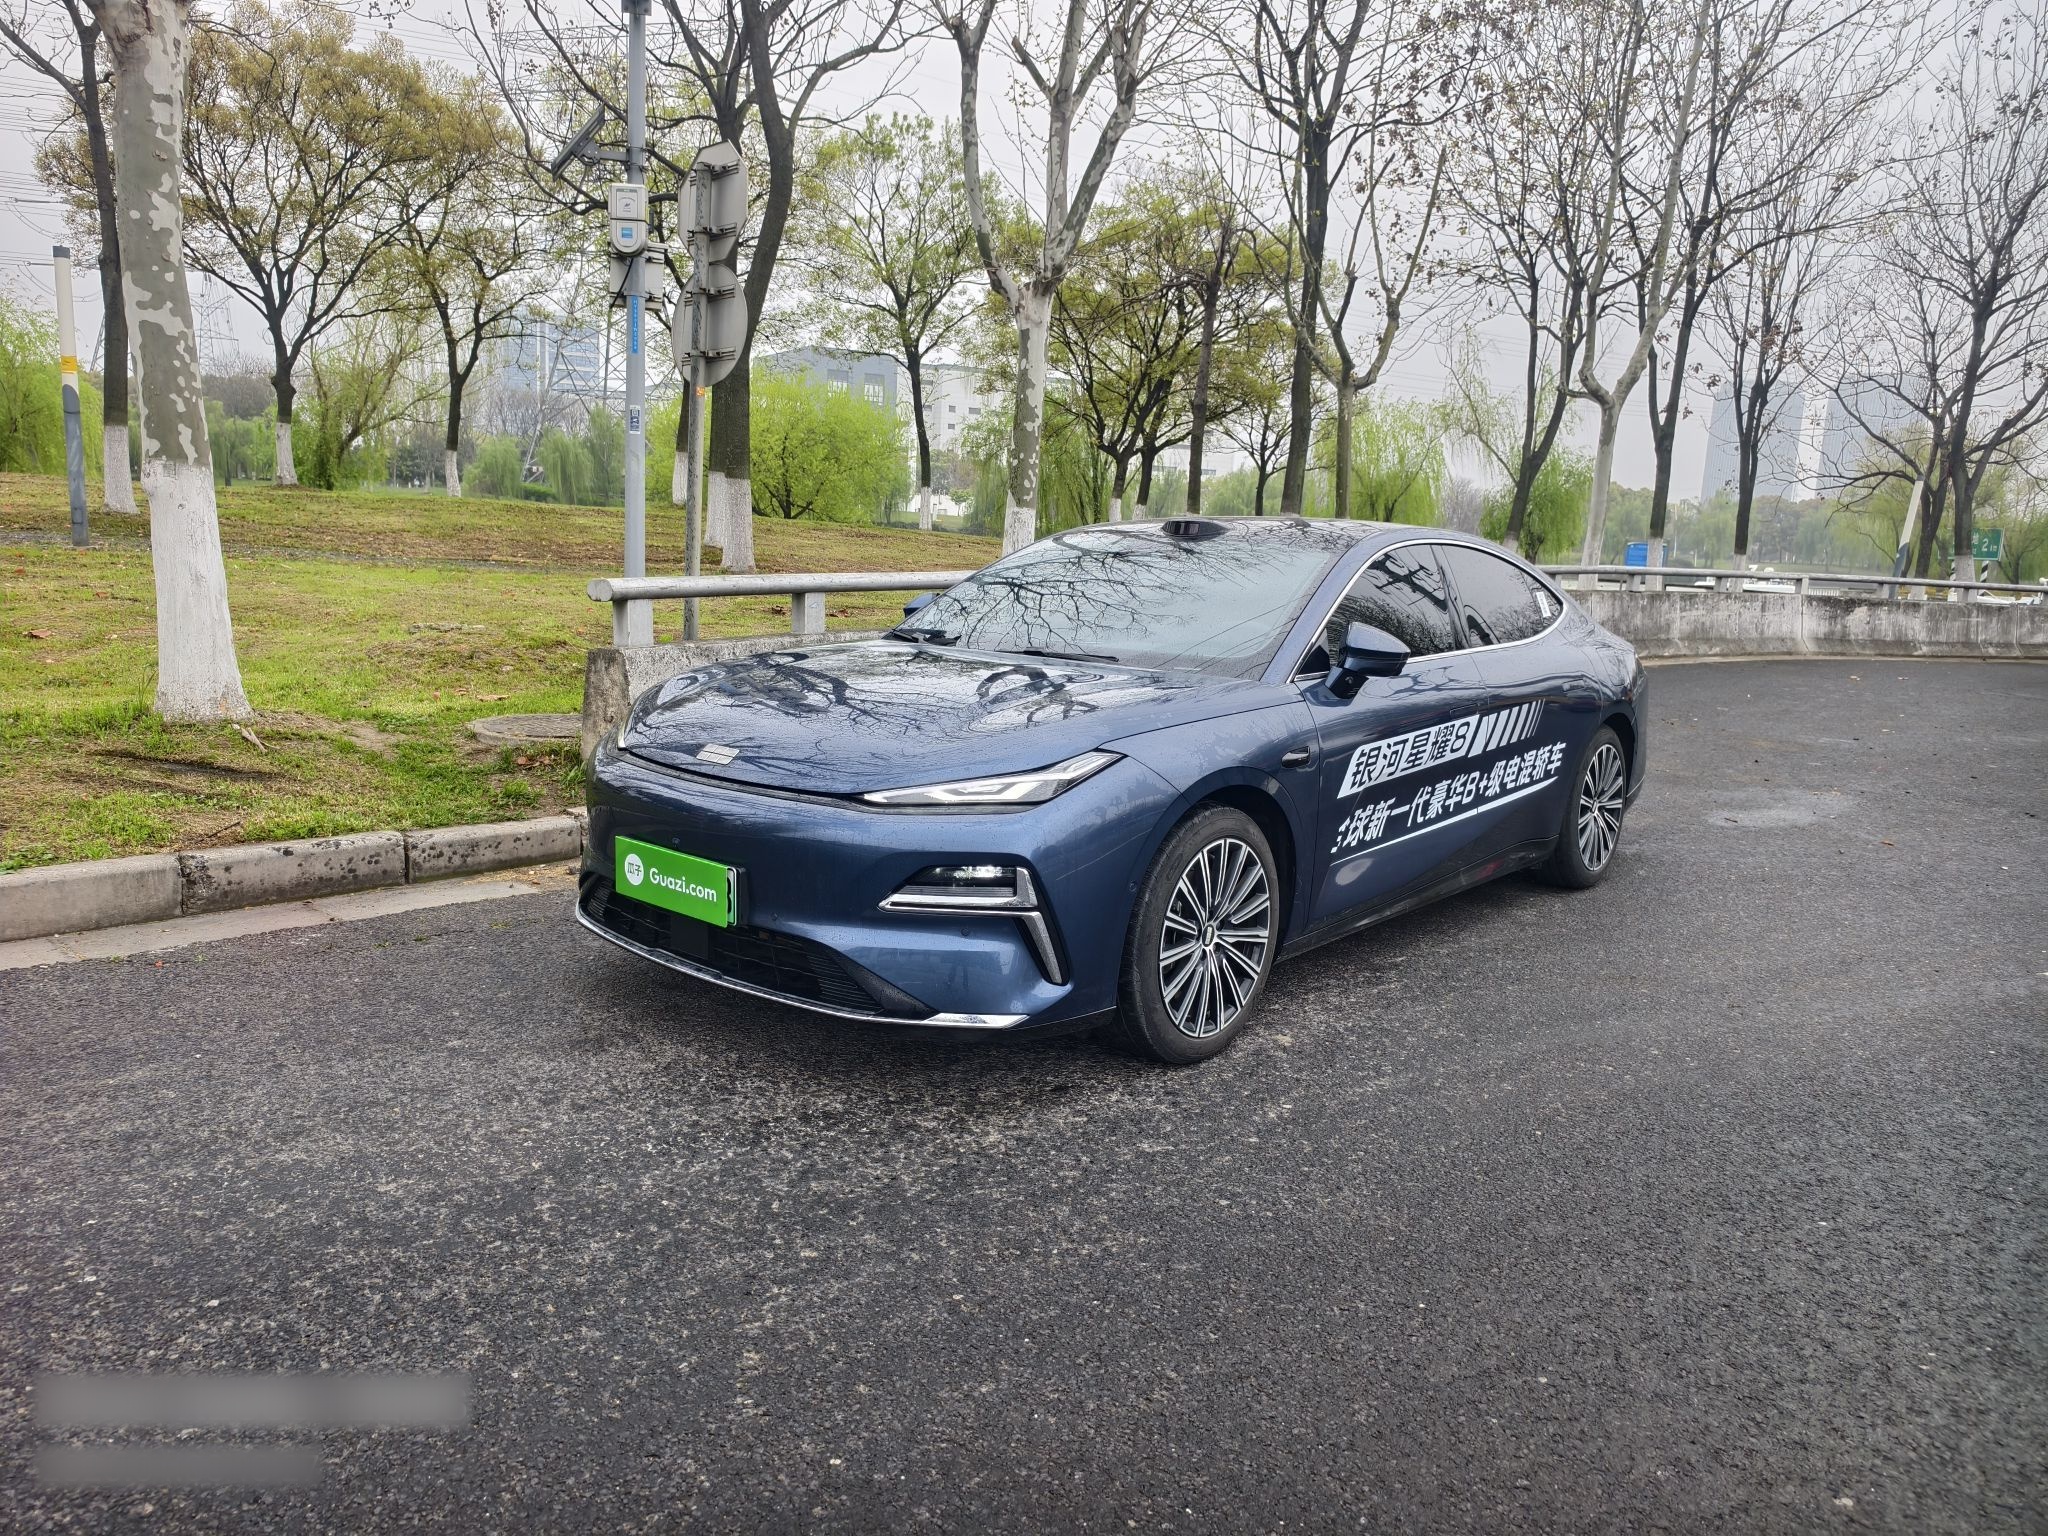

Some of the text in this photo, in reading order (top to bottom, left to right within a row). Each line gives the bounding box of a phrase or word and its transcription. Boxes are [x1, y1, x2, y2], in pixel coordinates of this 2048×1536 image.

[1982, 538, 1989, 551] 2
[1350, 721, 1471, 790] 银河星耀8
[627, 862, 642, 876] 瓜子
[650, 868, 717, 902] Guazi.com
